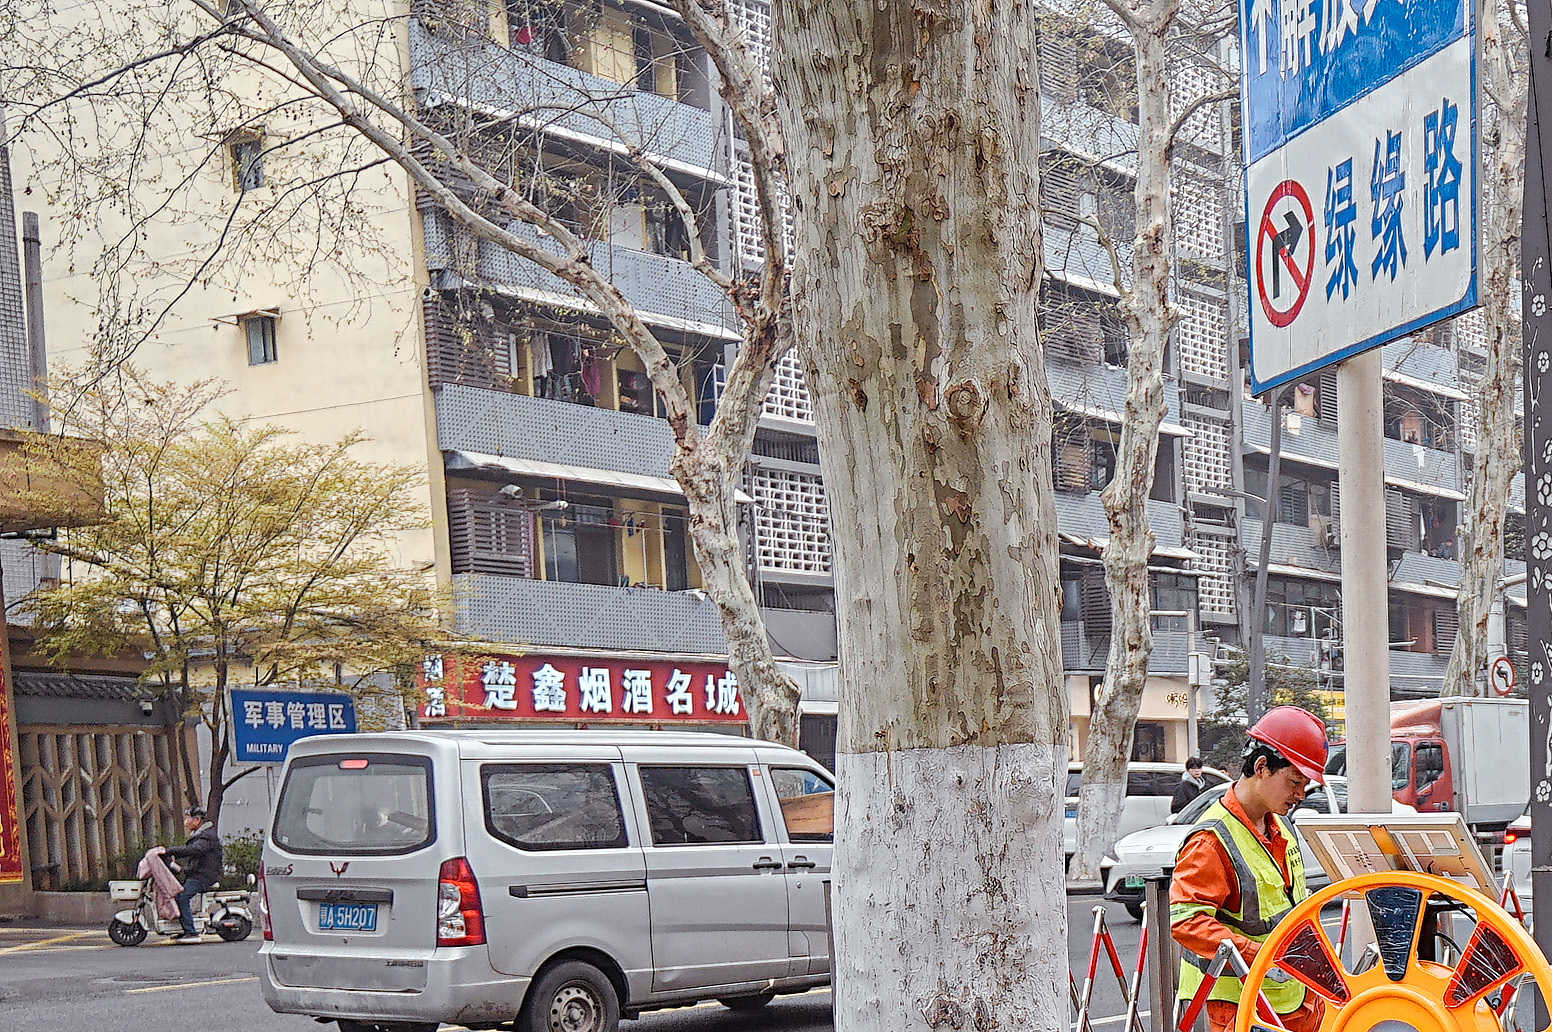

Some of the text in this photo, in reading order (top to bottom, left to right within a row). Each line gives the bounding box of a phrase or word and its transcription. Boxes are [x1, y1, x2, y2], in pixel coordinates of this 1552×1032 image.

[1324, 97, 1463, 303] 绿缘路
[481, 661, 740, 716] 楚鑫烟酒名城
[243, 701, 347, 729] 军事管理区
[246, 743, 283, 753] MILITARY
